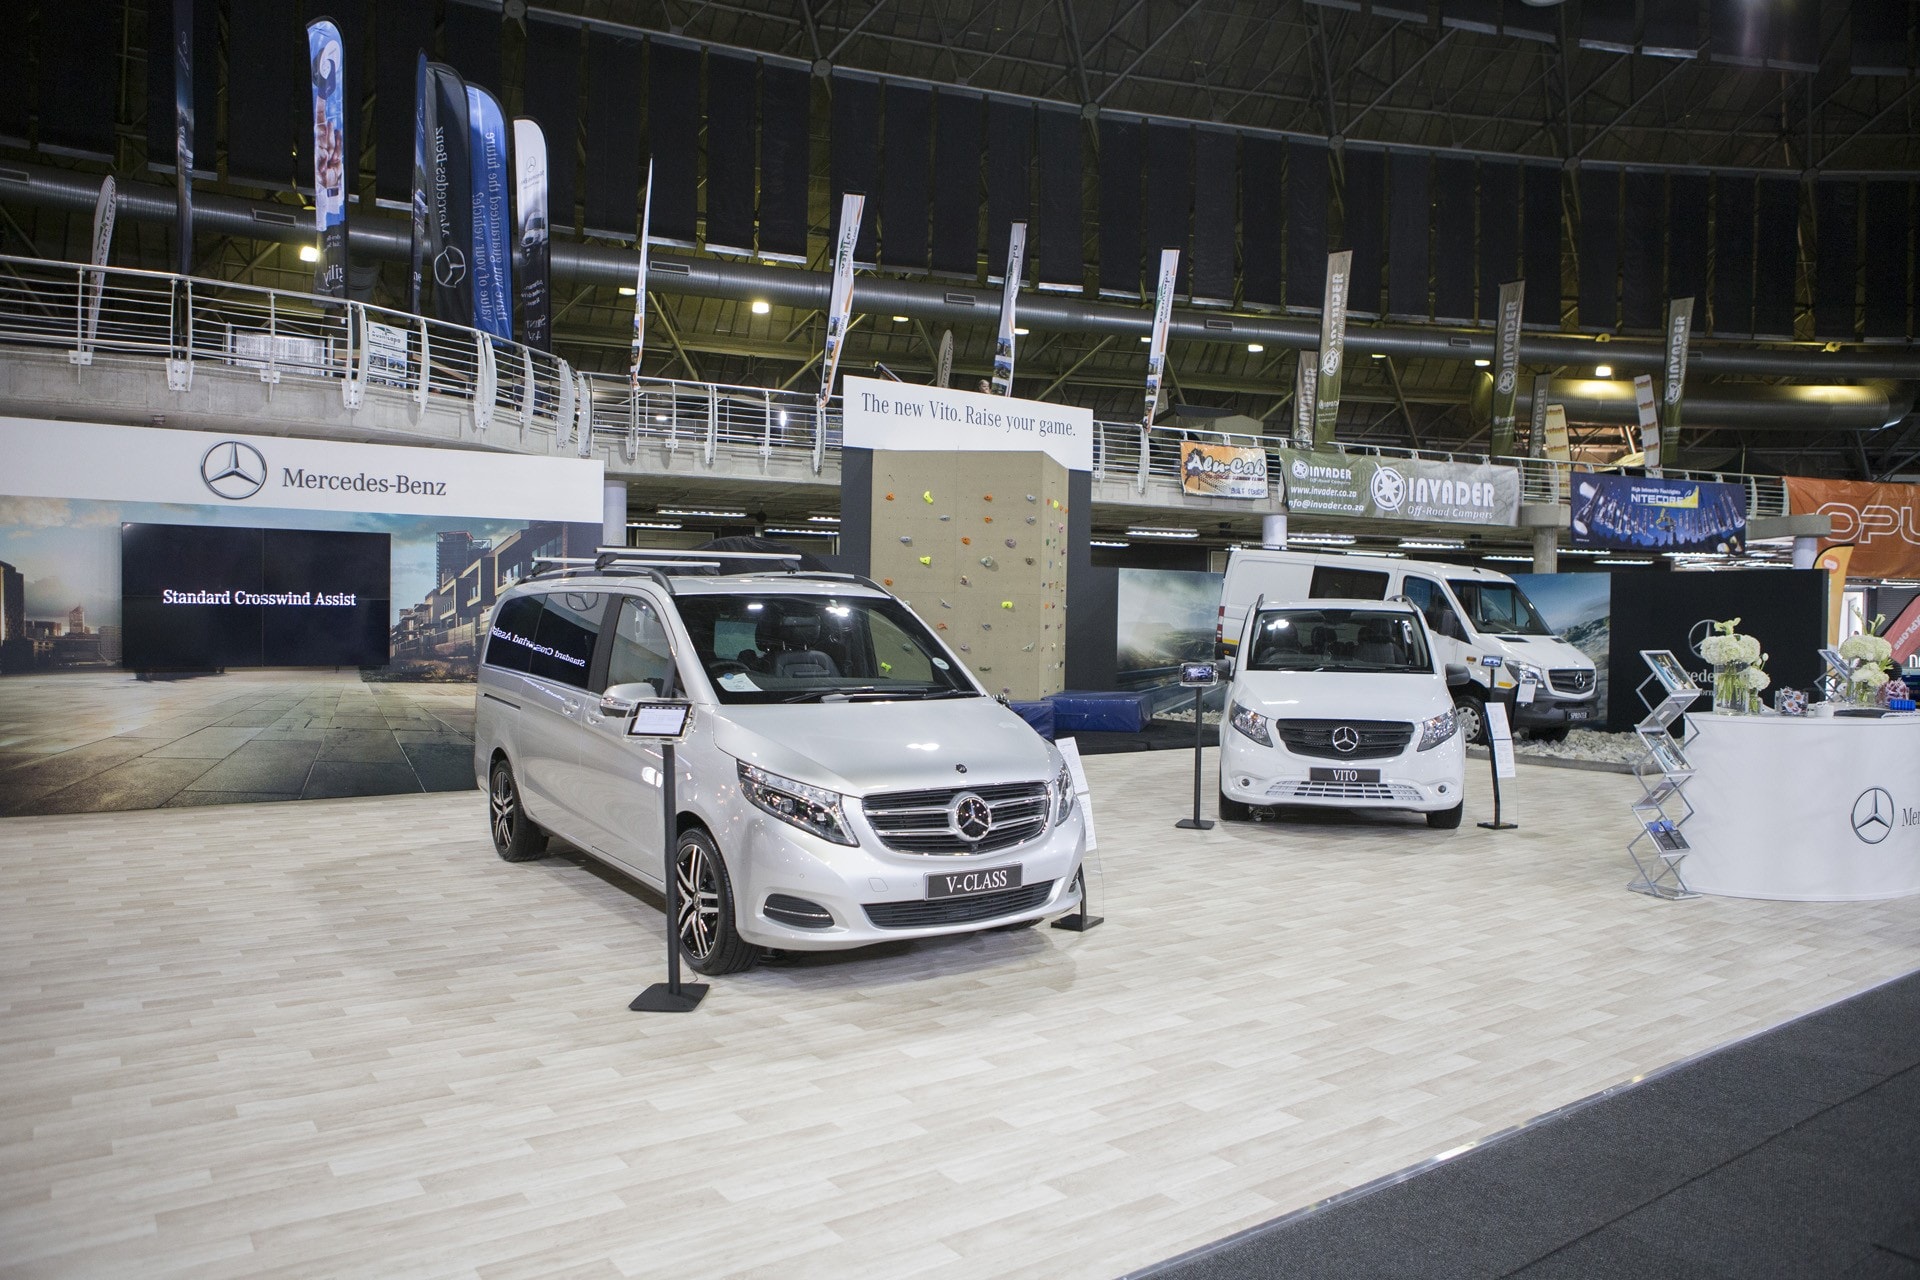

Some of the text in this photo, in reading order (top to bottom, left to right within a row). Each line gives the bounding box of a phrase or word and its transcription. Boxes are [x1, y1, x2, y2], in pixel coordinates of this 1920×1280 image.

[1502, 300, 1518, 368] INVADER
[1668, 315, 1686, 380] INVADER
[1298, 367, 1317, 426] INVADER
[862, 392, 1076, 438] The new Vito. Raise your game.
[1533, 388, 1546, 441] INVADER
[1186, 452, 1266, 477] Alu-Cab
[1310, 466, 1352, 480] INVADER
[282, 467, 447, 498] Mercedes-Benz
[1290, 486, 1357, 498] www.invader.co.za
[1408, 477, 1495, 508] INVADER
[1288, 499, 1365, 512] nfo@invader.co.za
[1631, 494, 1684, 505] NITECORE
[1407, 505, 1494, 520] Off-Road Campers
[163, 588, 357, 607] Standard Crosswind Assist
[1333, 769, 1358, 783] VITO
[945, 868, 1008, 894] V-CLASS
